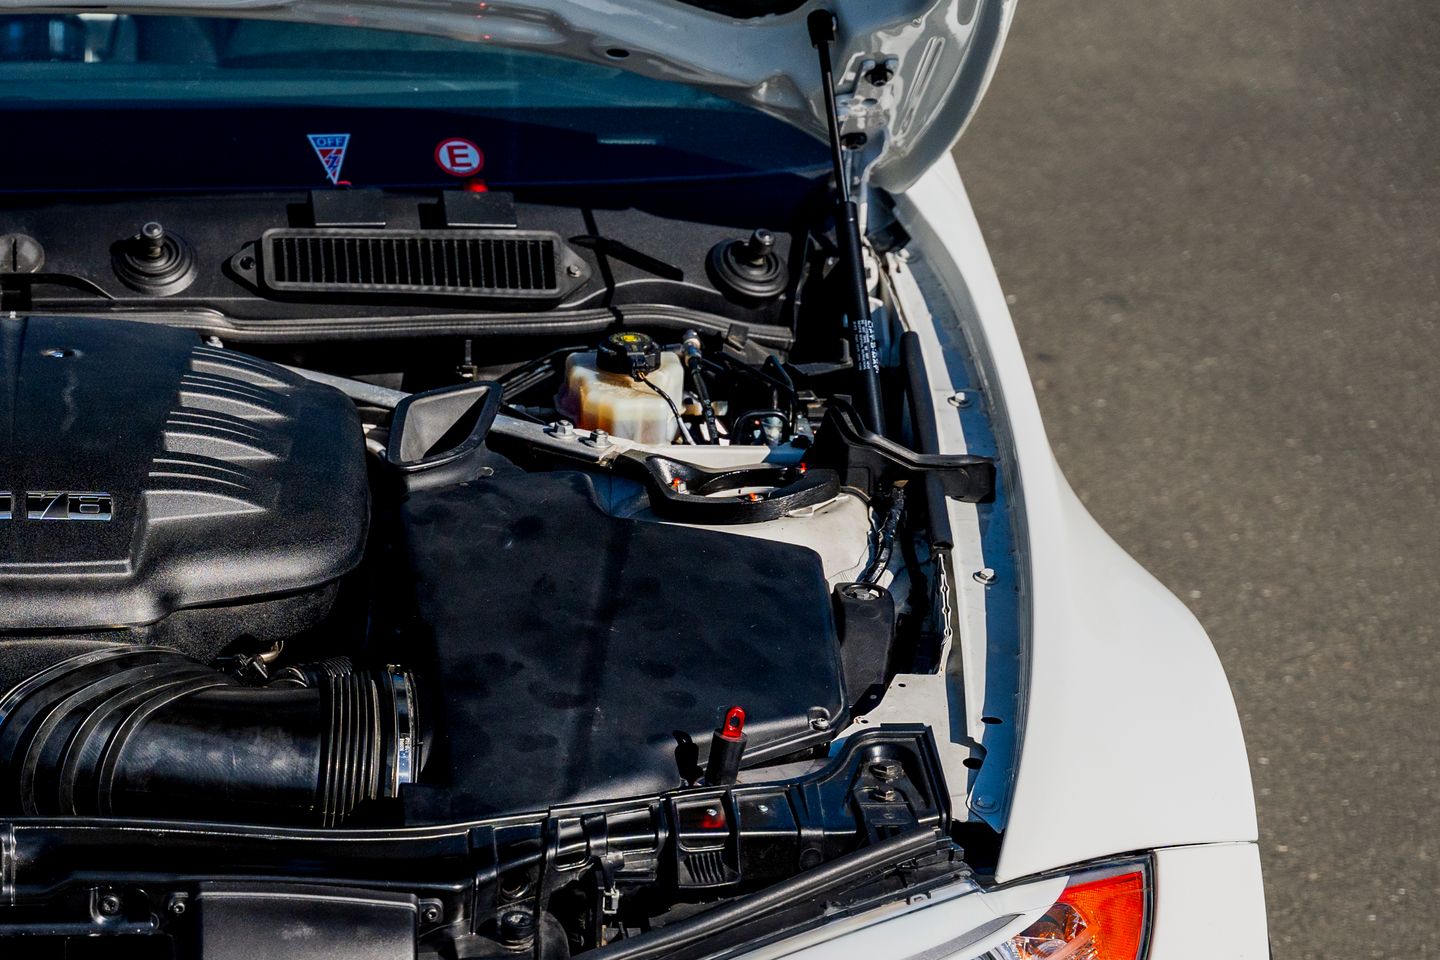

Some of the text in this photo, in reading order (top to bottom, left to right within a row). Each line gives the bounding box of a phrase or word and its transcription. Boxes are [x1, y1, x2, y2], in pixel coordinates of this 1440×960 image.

[316, 136, 344, 147] OFF
[446, 145, 472, 168] E
[26, 491, 113, 520] V8
